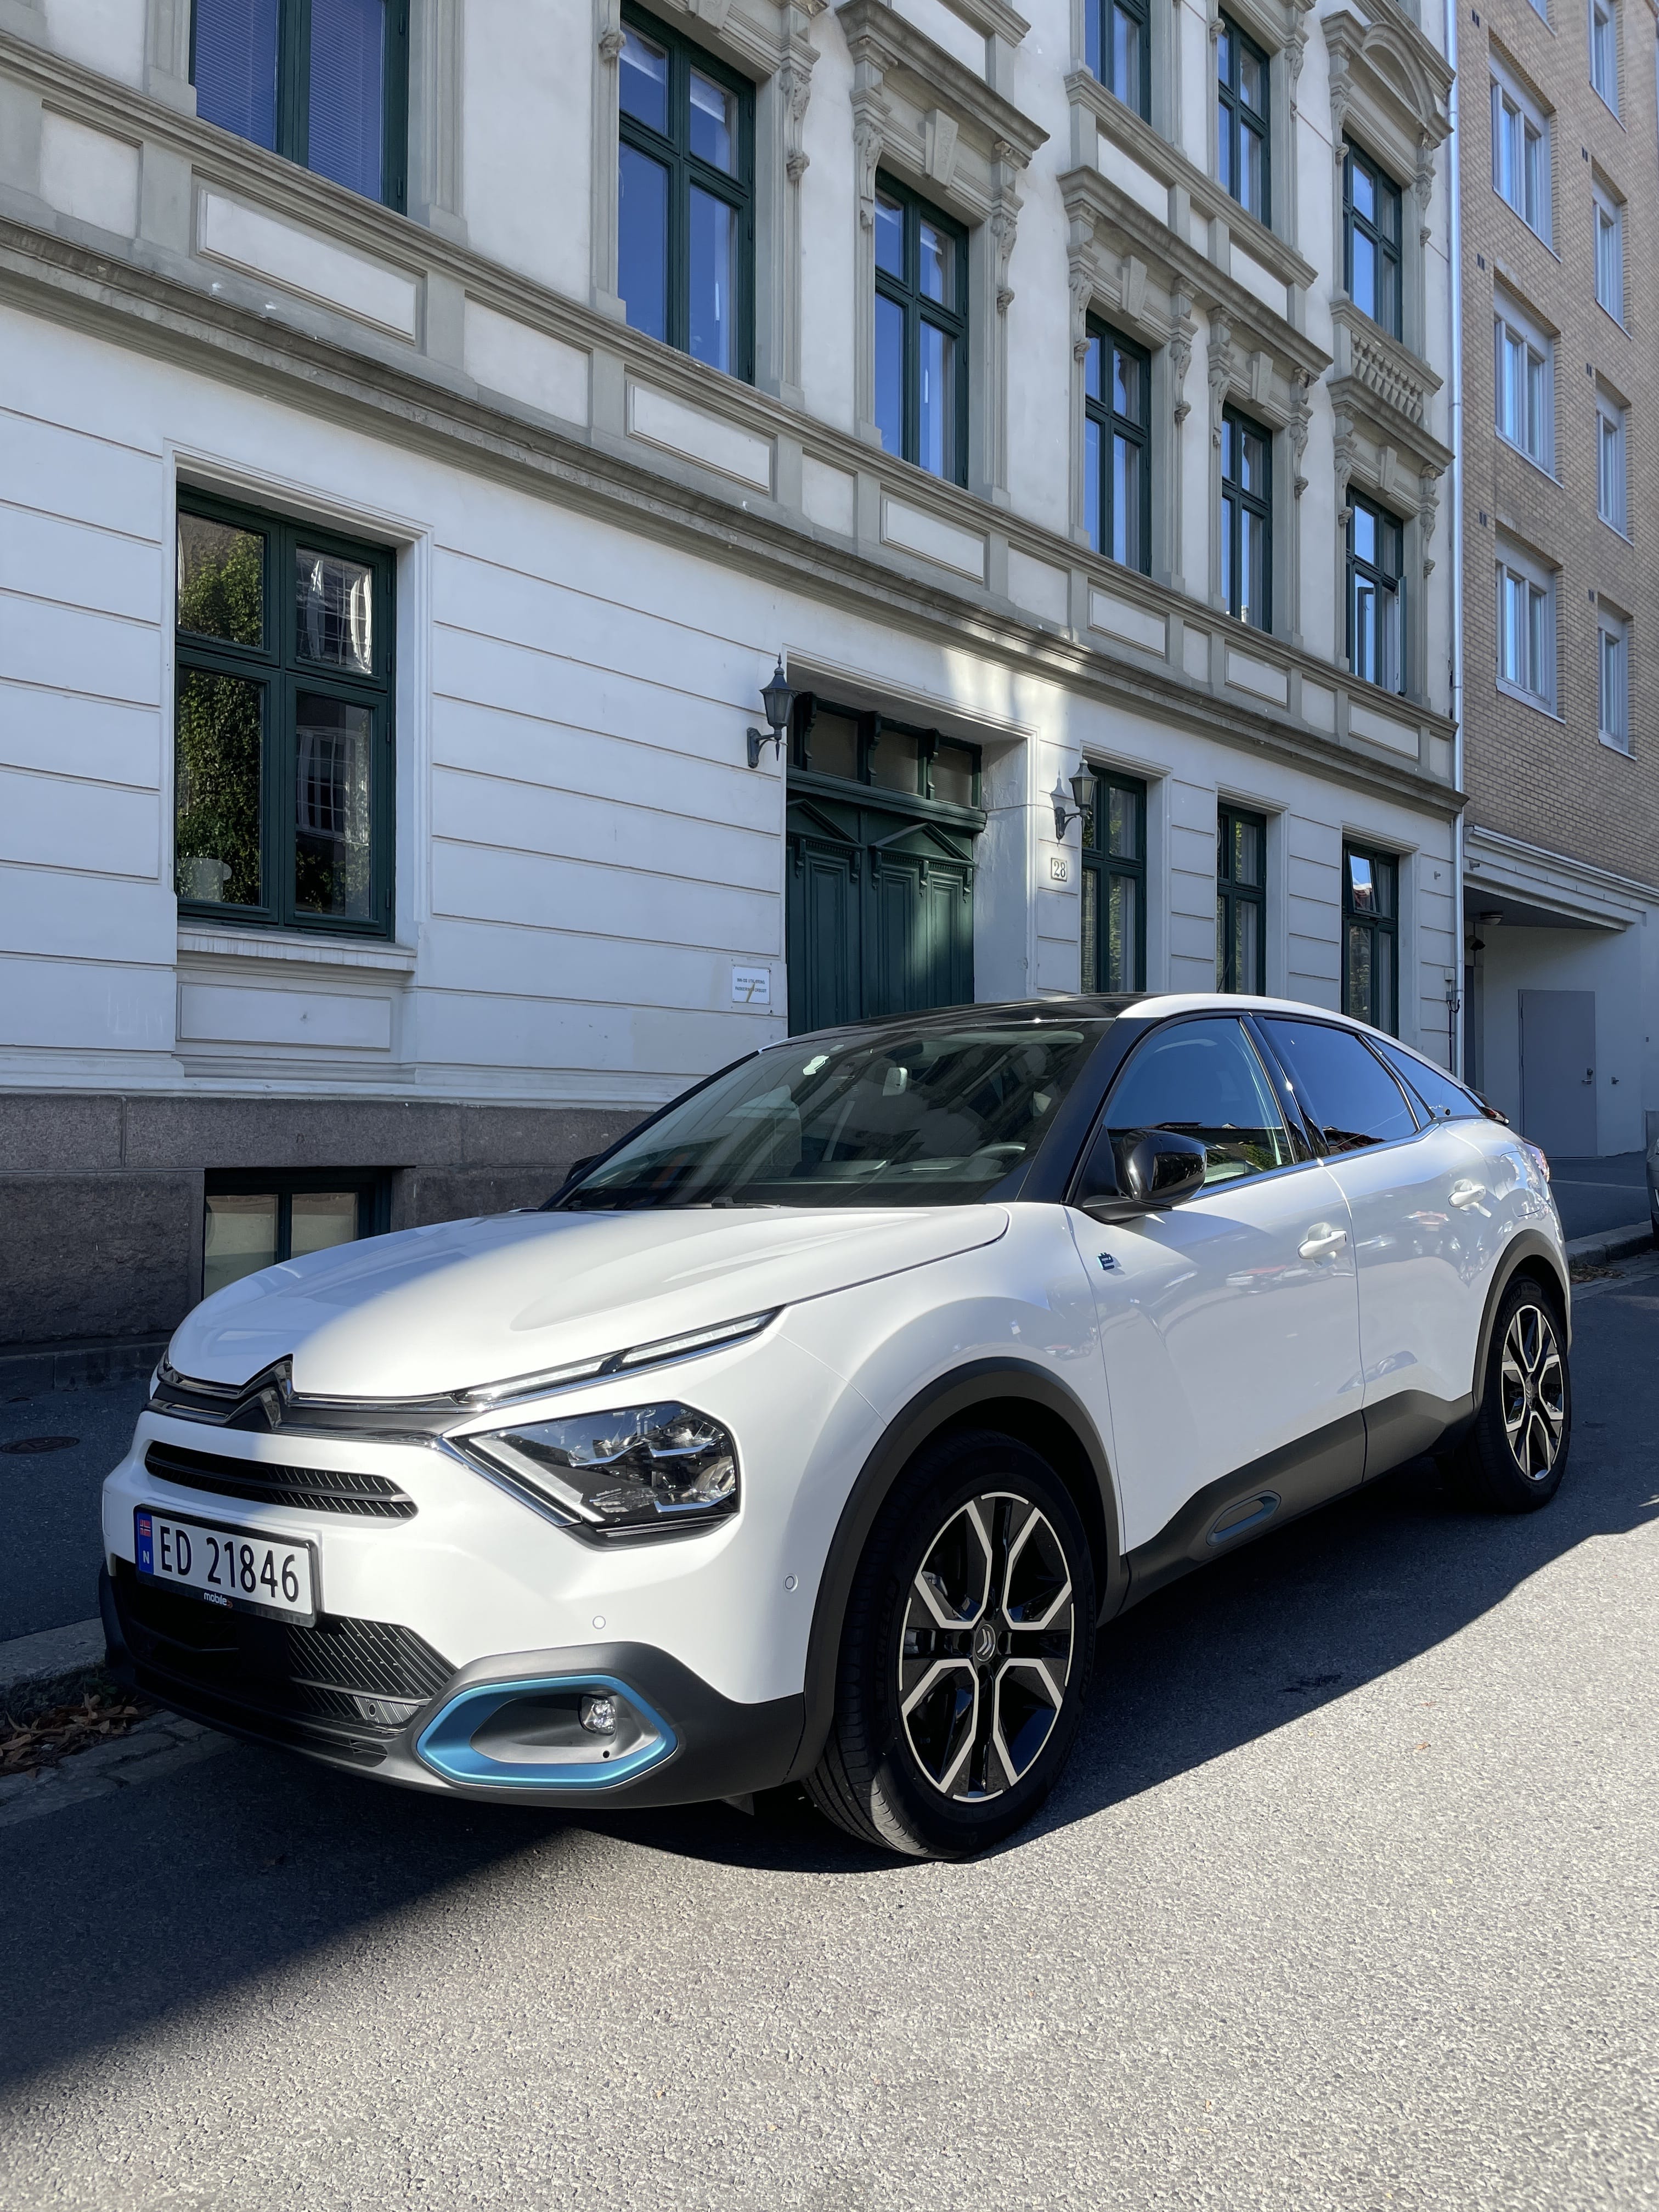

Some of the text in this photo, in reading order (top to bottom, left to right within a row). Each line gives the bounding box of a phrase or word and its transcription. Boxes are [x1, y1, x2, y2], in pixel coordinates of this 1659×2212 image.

[1054, 861, 1066, 878] 28
[143, 1550, 150, 1564] N
[160, 1525, 299, 1602] ED 21846
[204, 1592, 227, 1606] mobile
